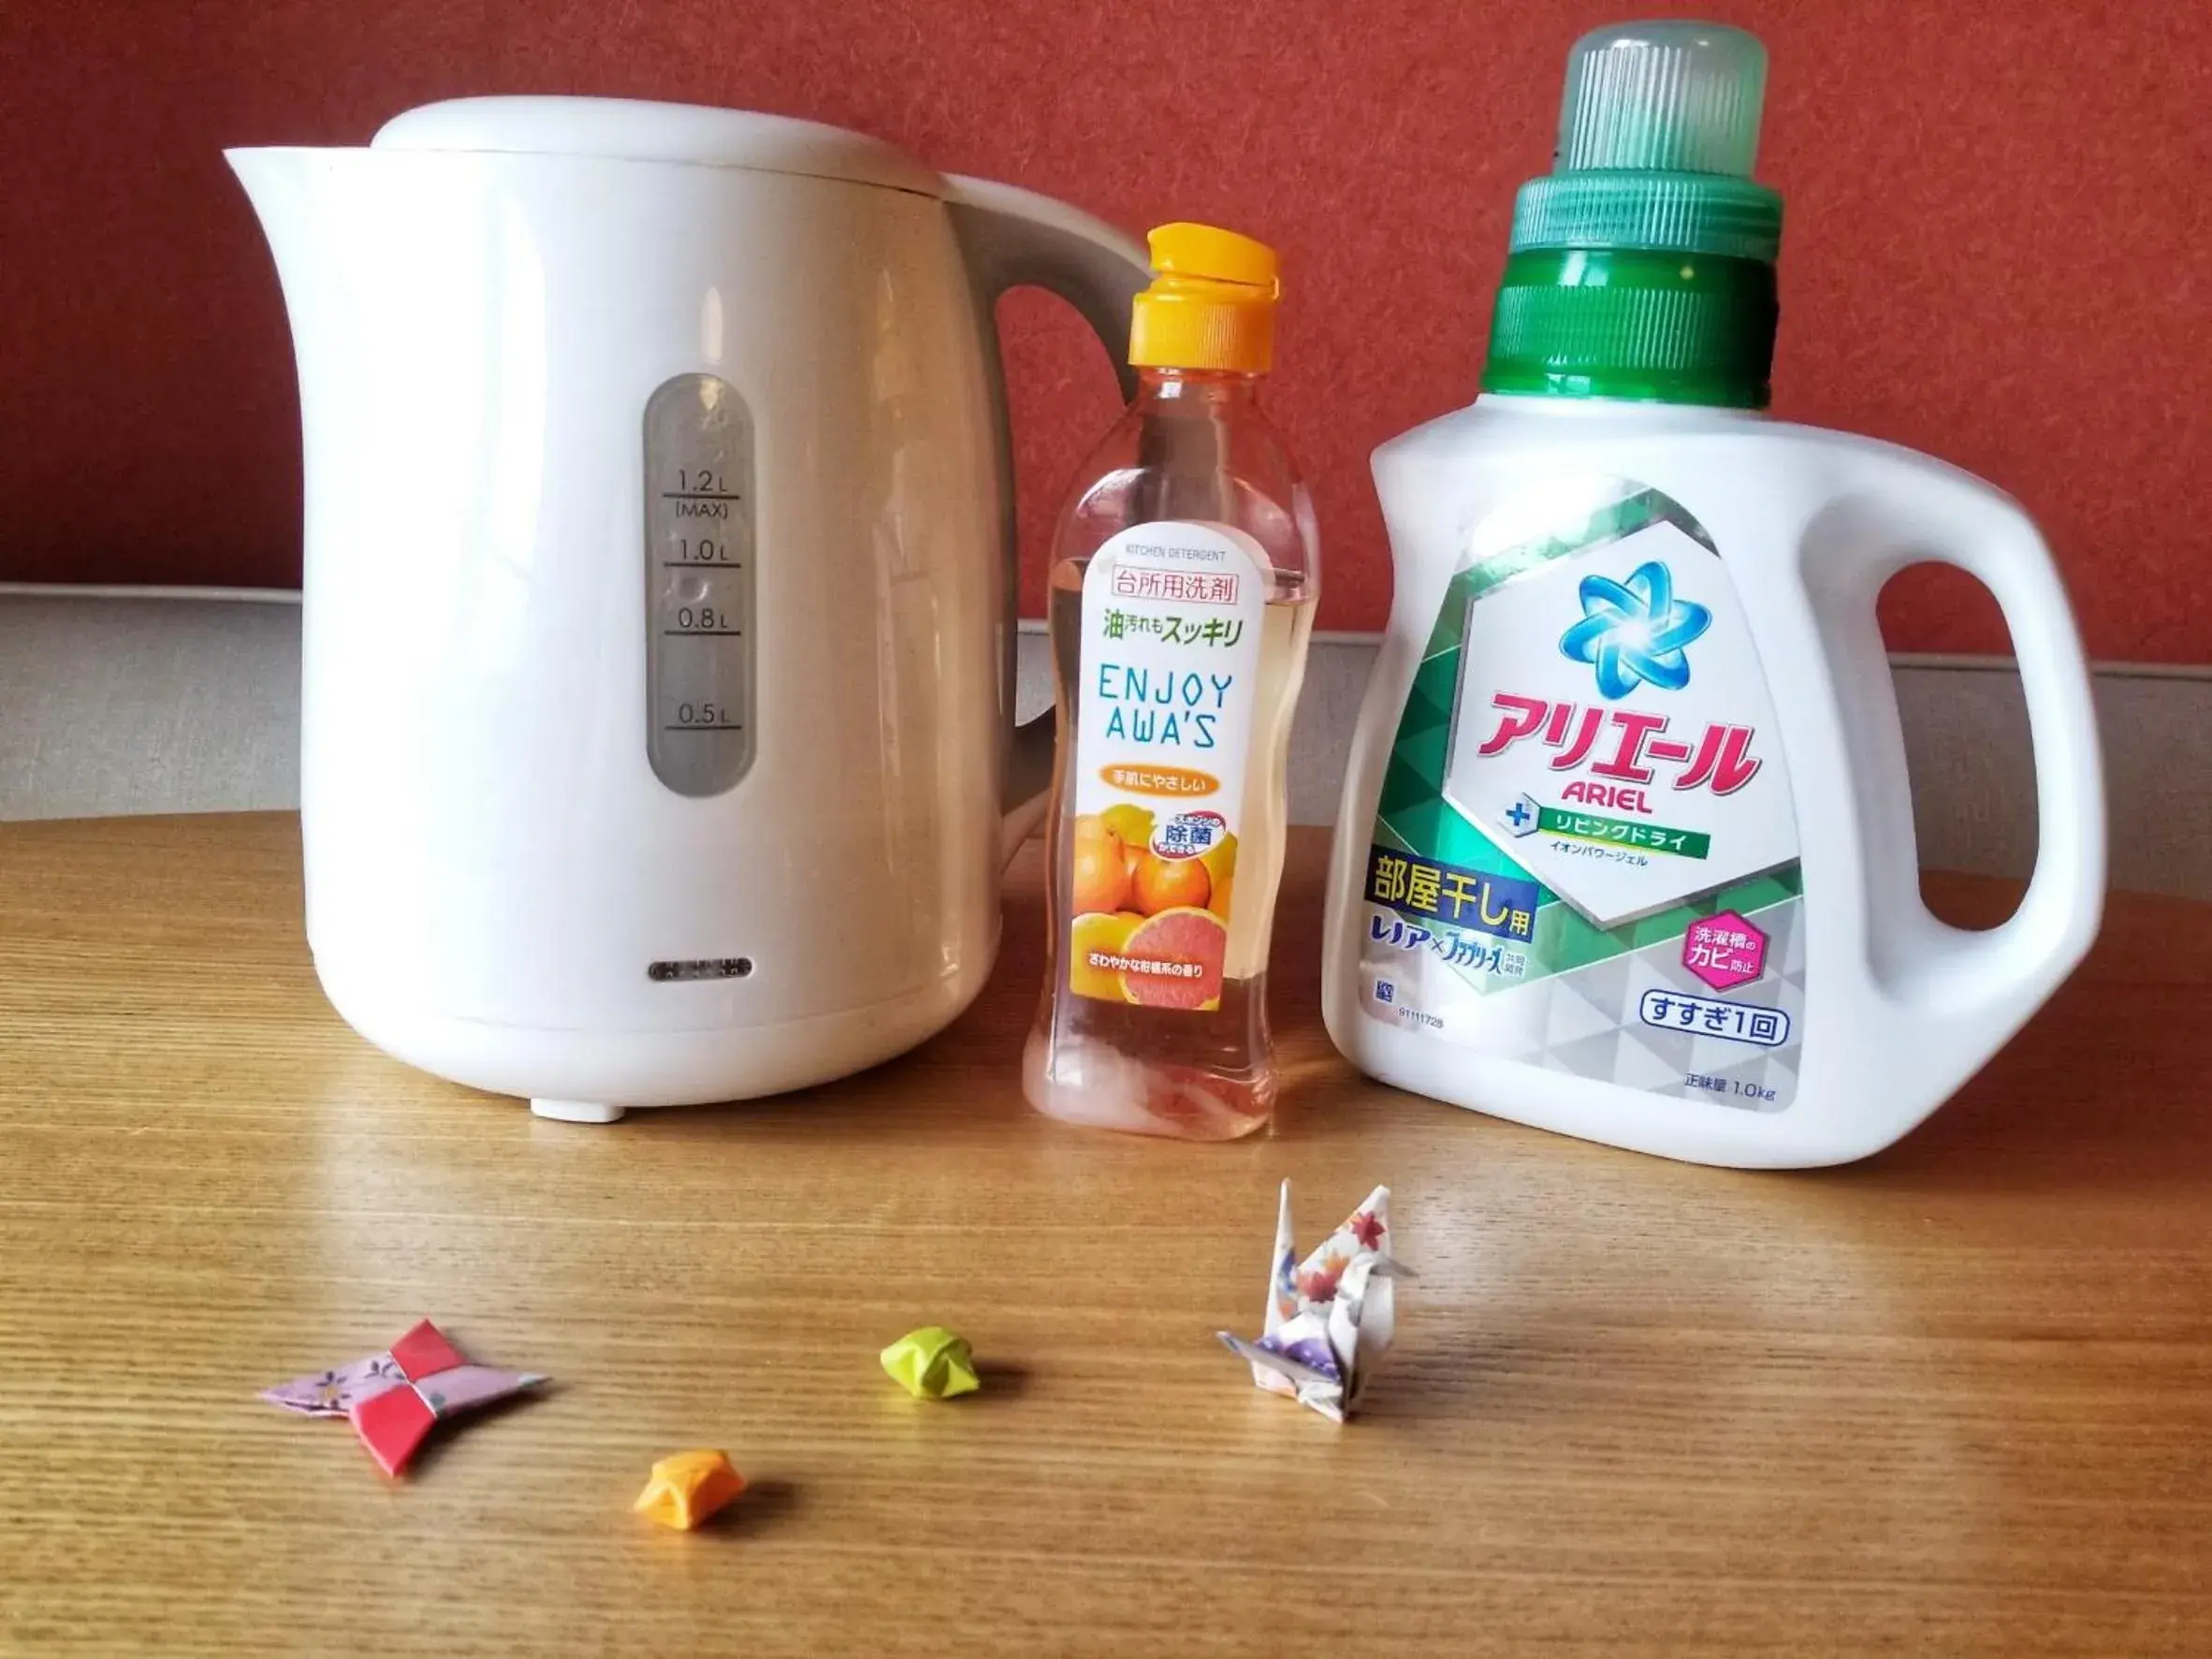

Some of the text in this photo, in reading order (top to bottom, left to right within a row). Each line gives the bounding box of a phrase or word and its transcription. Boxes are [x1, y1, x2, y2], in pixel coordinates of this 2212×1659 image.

[676, 502, 728, 518] (MAX)
[1126, 544, 1227, 561] KITCHEN DETERGENT
[1116, 570, 1233, 602] 台所用洗剤
[1103, 608, 1244, 648] 油汚れもスッキリ
[1099, 662, 1232, 708] ENJOY
[1106, 706, 1216, 749] AWA'S
[1477, 690, 1763, 796] アリエール
[1112, 768, 1206, 793] 手肌にやさしい
[1561, 780, 1653, 814] ARIEL
[1166, 824, 1212, 845] 除菌
[1556, 813, 1687, 851] リビングドライ
[1550, 840, 1649, 866] イオンパワージェル
[1374, 855, 1533, 936] 部屋干し用
[1695, 925, 1756, 951] 洗濯槽の
[1688, 945, 1755, 974] カビ防止
[1651, 997, 1779, 1041] すすぎ1回
[1684, 1071, 1777, 1102] 正味量 1.0kg
